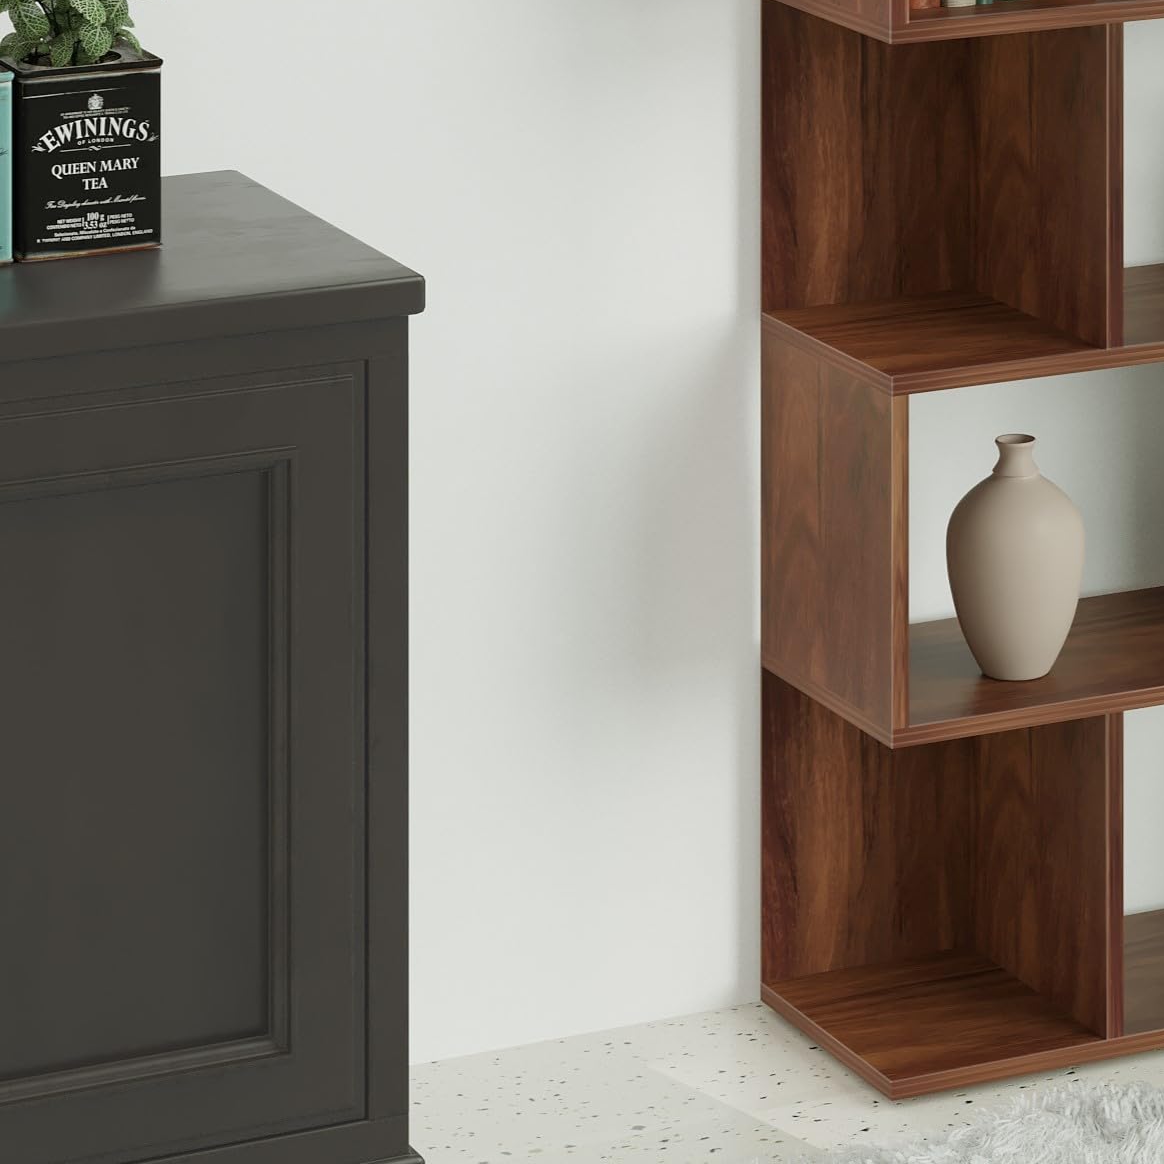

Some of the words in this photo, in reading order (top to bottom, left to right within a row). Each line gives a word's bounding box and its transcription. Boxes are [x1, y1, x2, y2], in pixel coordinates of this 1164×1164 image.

[39, 116, 150, 153] EWININGS
[51, 161, 97, 179] QUEEN
[99, 157, 140, 172] MARY
[82, 177, 108, 191] TEA
